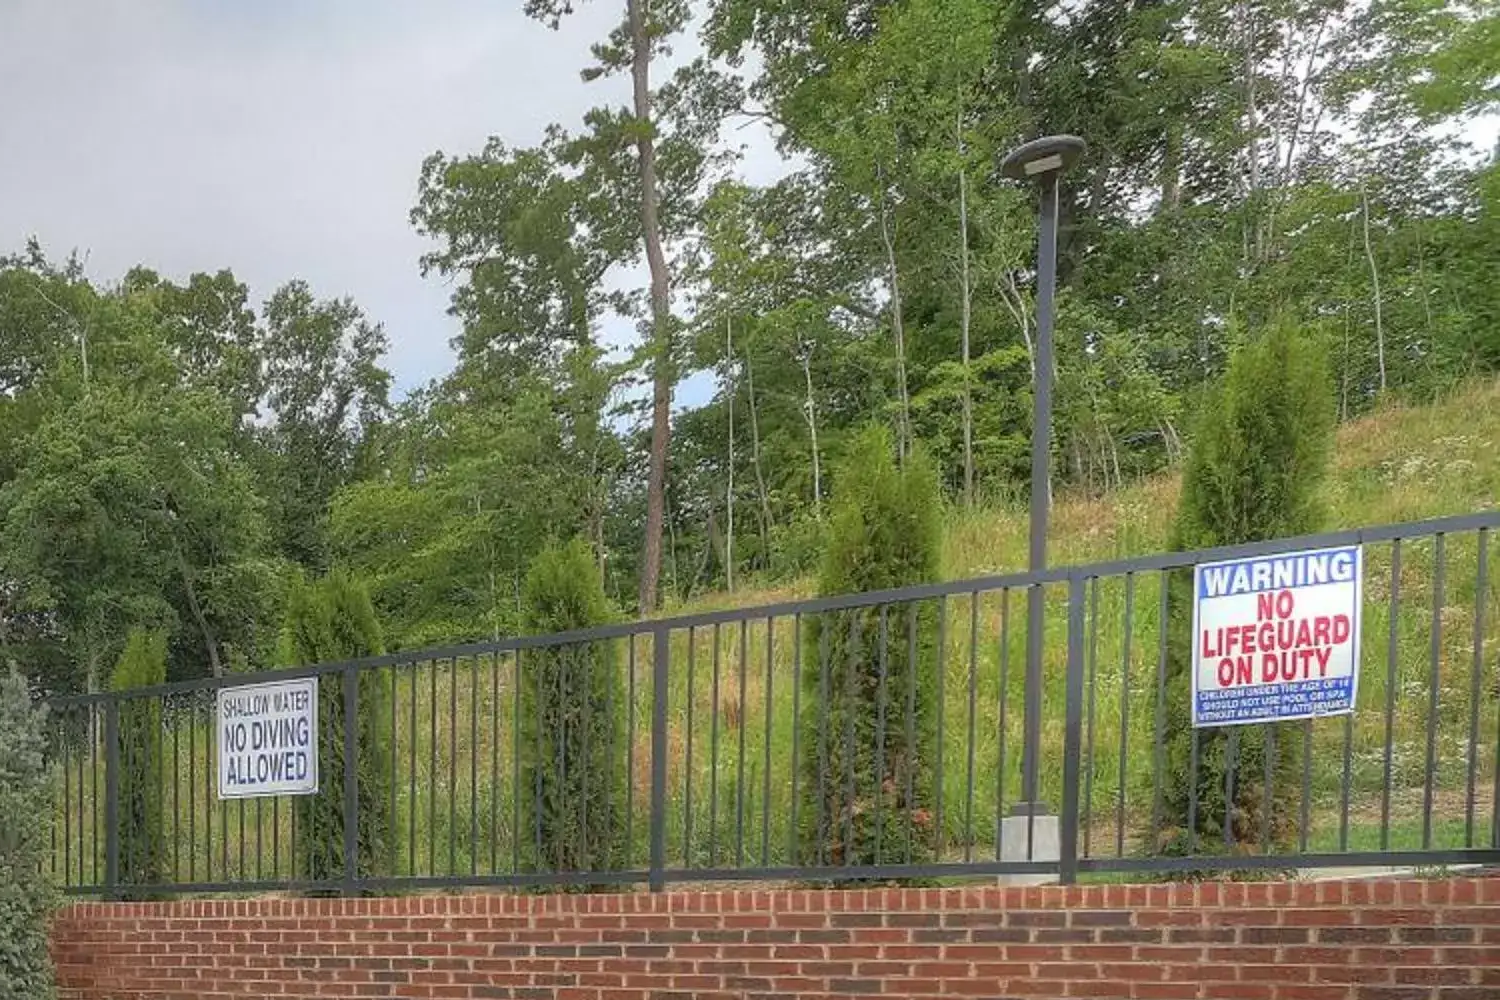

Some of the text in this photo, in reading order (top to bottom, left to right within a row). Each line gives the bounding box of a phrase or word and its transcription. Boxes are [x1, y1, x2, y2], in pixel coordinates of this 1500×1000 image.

[1203, 552, 1353, 596] WARNING
[1257, 589, 1294, 621] NO
[1203, 614, 1350, 658] LIFEGUARD
[1217, 647, 1332, 687] ON DUTY
[223, 690, 309, 719] SHALLOW WATER
[225, 717, 309, 753] NO DIVING
[227, 751, 307, 785] ALLOWED
